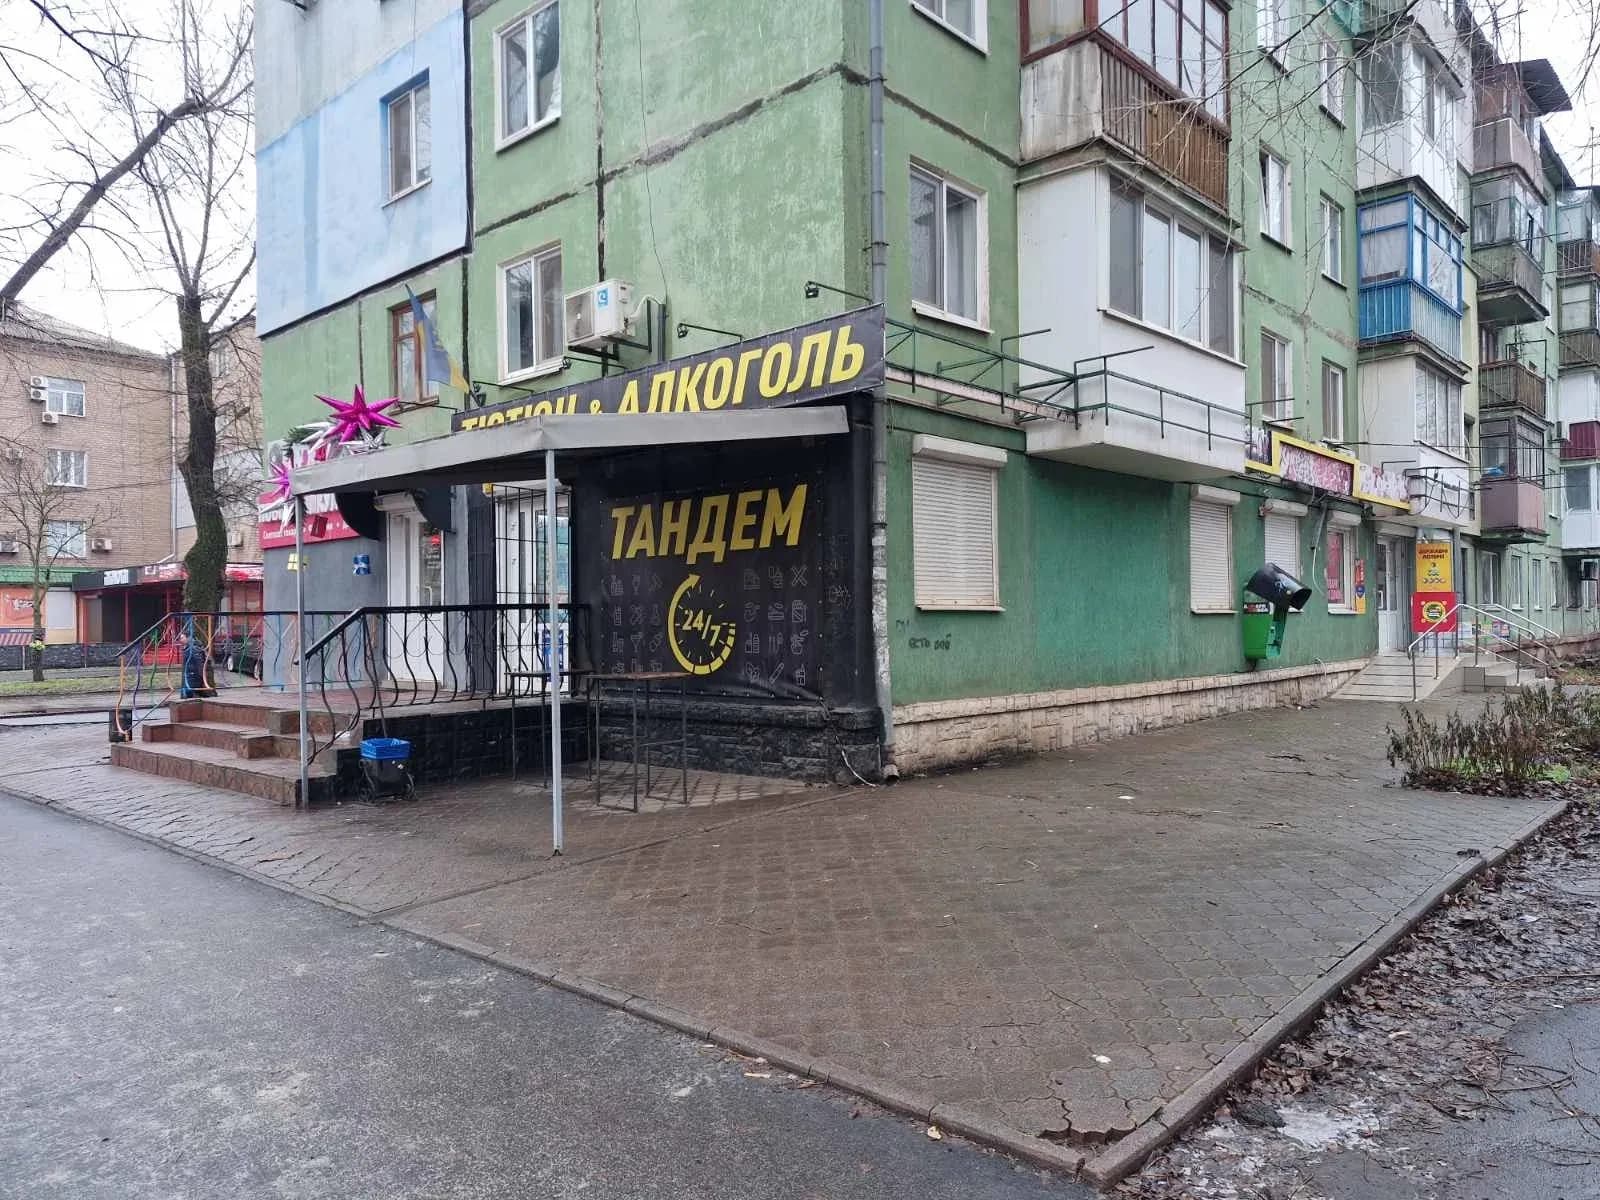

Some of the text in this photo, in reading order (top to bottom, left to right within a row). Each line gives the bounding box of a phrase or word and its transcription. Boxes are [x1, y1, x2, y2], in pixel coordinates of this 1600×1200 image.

[617, 325, 865, 414] АЛКОГОЛЬ
[612, 484, 808, 565] ТАНДЕМ
[682, 609, 721, 647] 24/7
